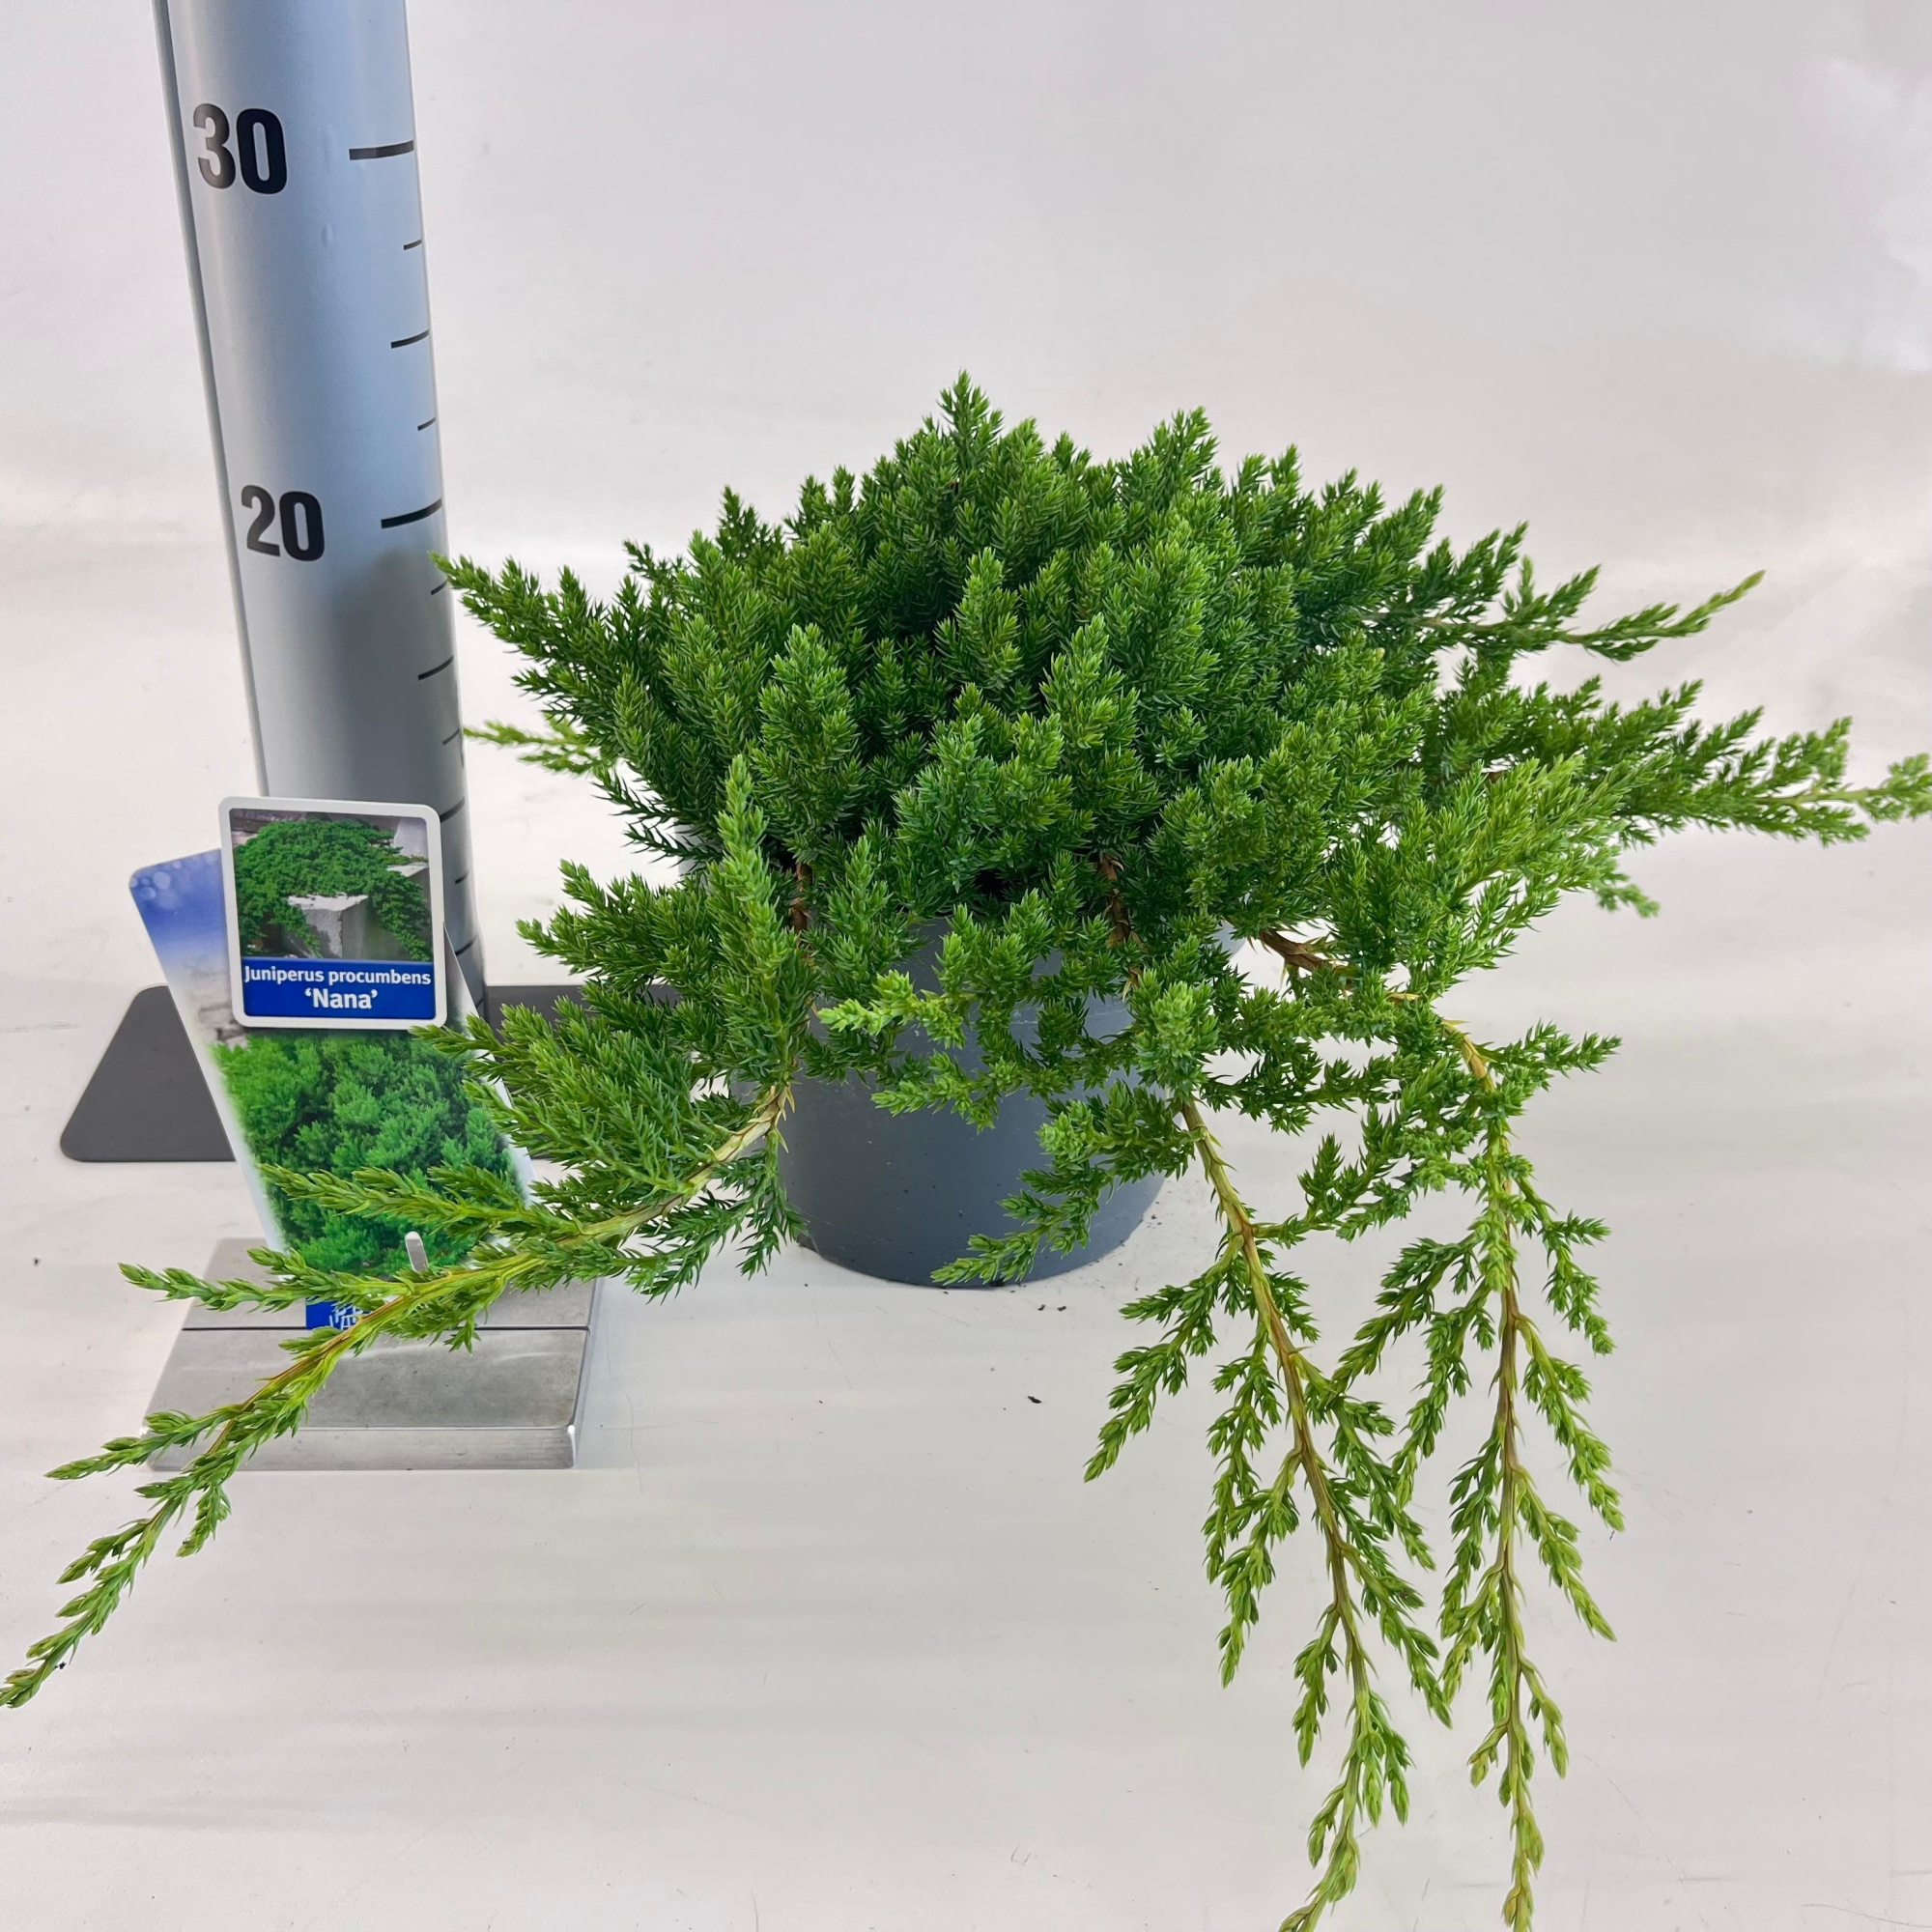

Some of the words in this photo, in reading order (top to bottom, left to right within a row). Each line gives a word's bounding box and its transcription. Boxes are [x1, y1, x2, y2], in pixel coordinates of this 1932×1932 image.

[193, 103, 288, 194] 30
[242, 484, 325, 561] 20
[244, 965, 325, 984] Juniperus
[328, 969, 432, 985] procumbens
